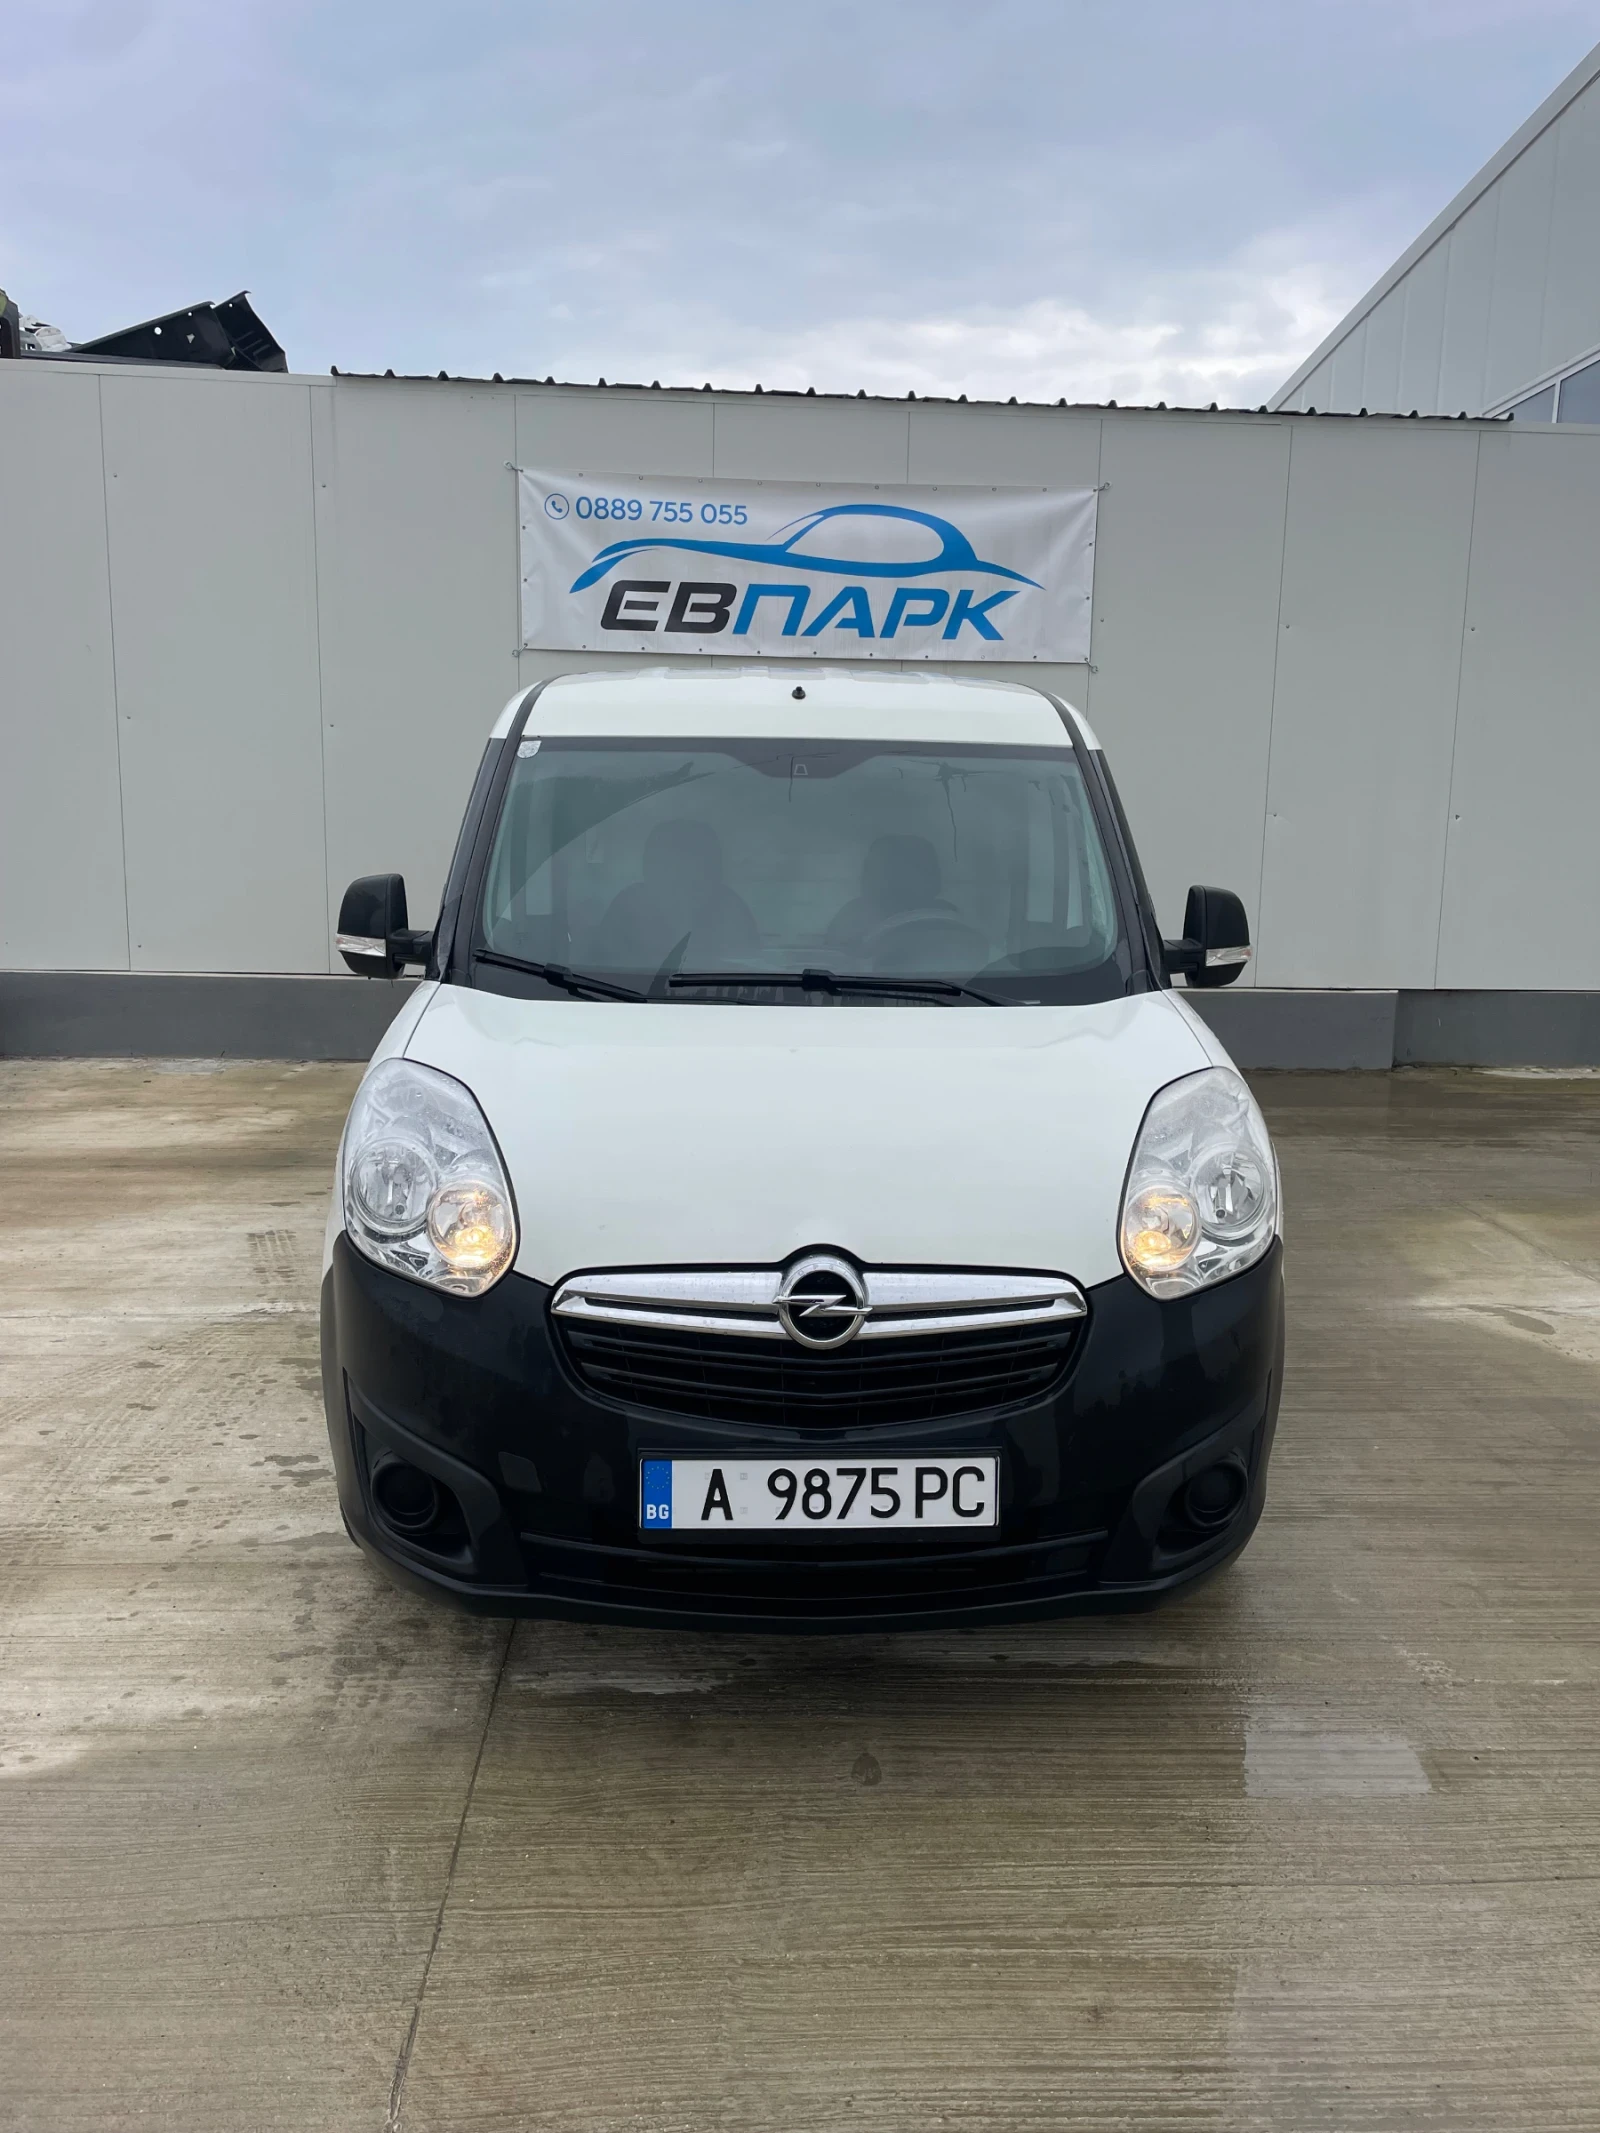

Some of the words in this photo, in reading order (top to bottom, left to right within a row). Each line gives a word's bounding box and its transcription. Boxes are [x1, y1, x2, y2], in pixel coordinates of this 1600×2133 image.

[575, 497, 643, 521] 0889
[649, 500, 693, 524] 755
[699, 502, 749, 526] 055
[600, 579, 1020, 640] ЕВПАРК
[646, 1504, 669, 1520] BG
[701, 1469, 733, 1521] A
